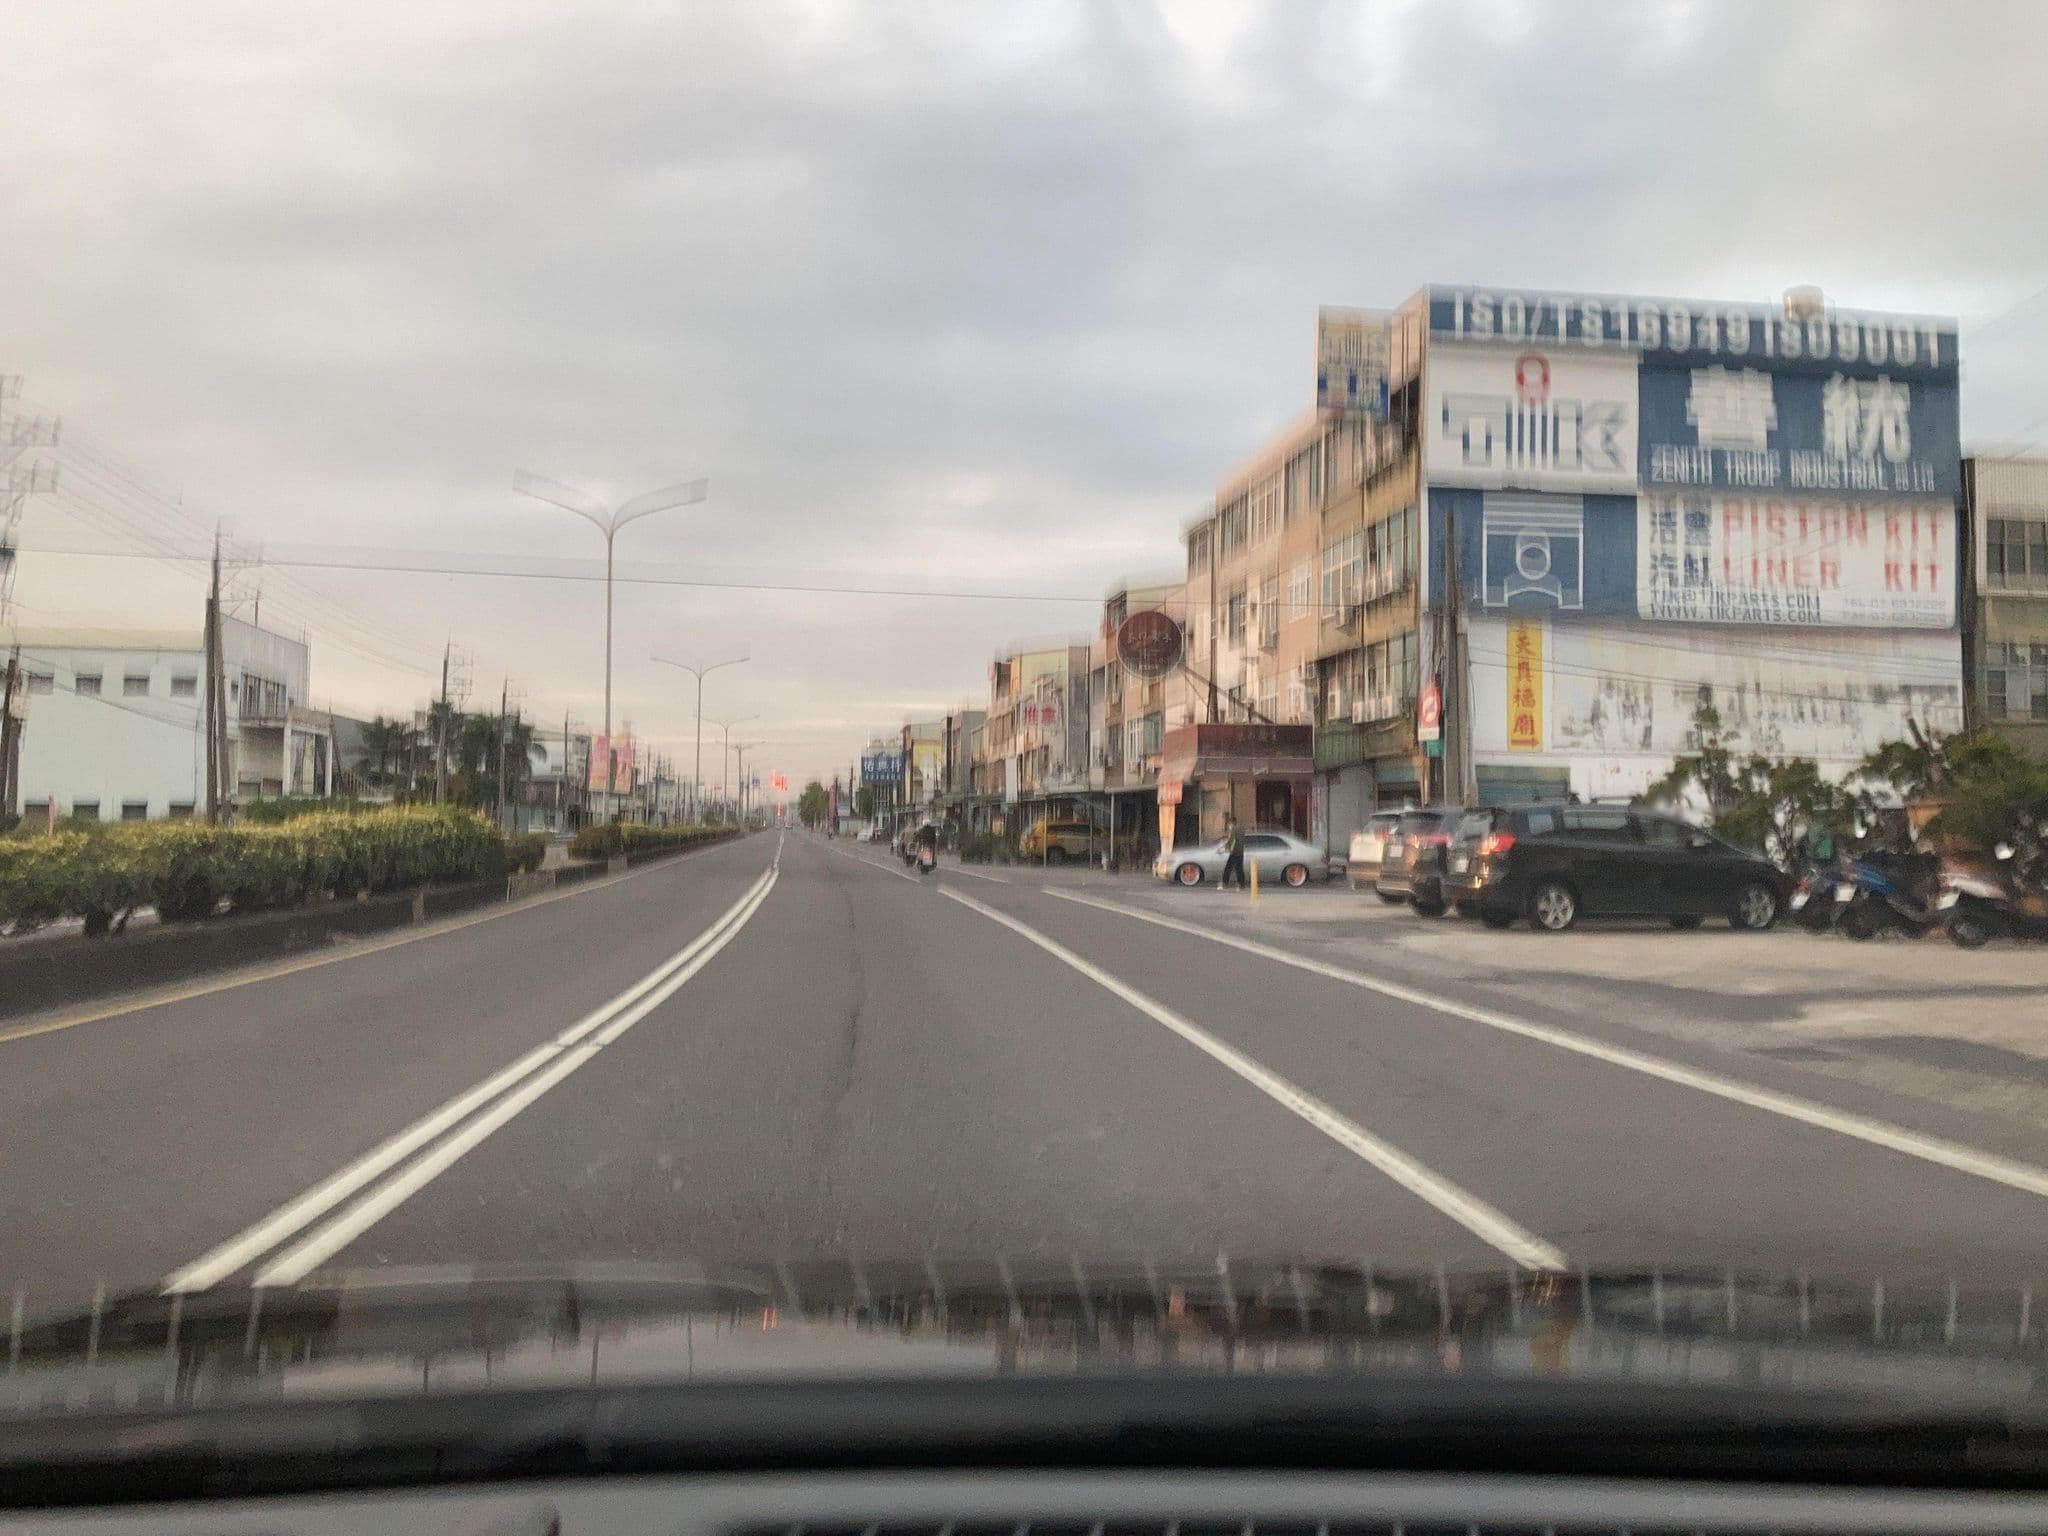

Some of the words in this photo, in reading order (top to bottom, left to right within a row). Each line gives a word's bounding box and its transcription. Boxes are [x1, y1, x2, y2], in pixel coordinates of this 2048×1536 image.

[1651, 445, 1713, 485] ZENITH
[1790, 449, 1889, 491] INDUSTRIAL
[1722, 502, 1868, 546] PISTON
[1884, 505, 1940, 550] KIT
[1723, 556, 1839, 591] LINER
[1884, 560, 1940, 593] KIT
[1650, 602, 1821, 625] WWW.TIKPARTS.COM
